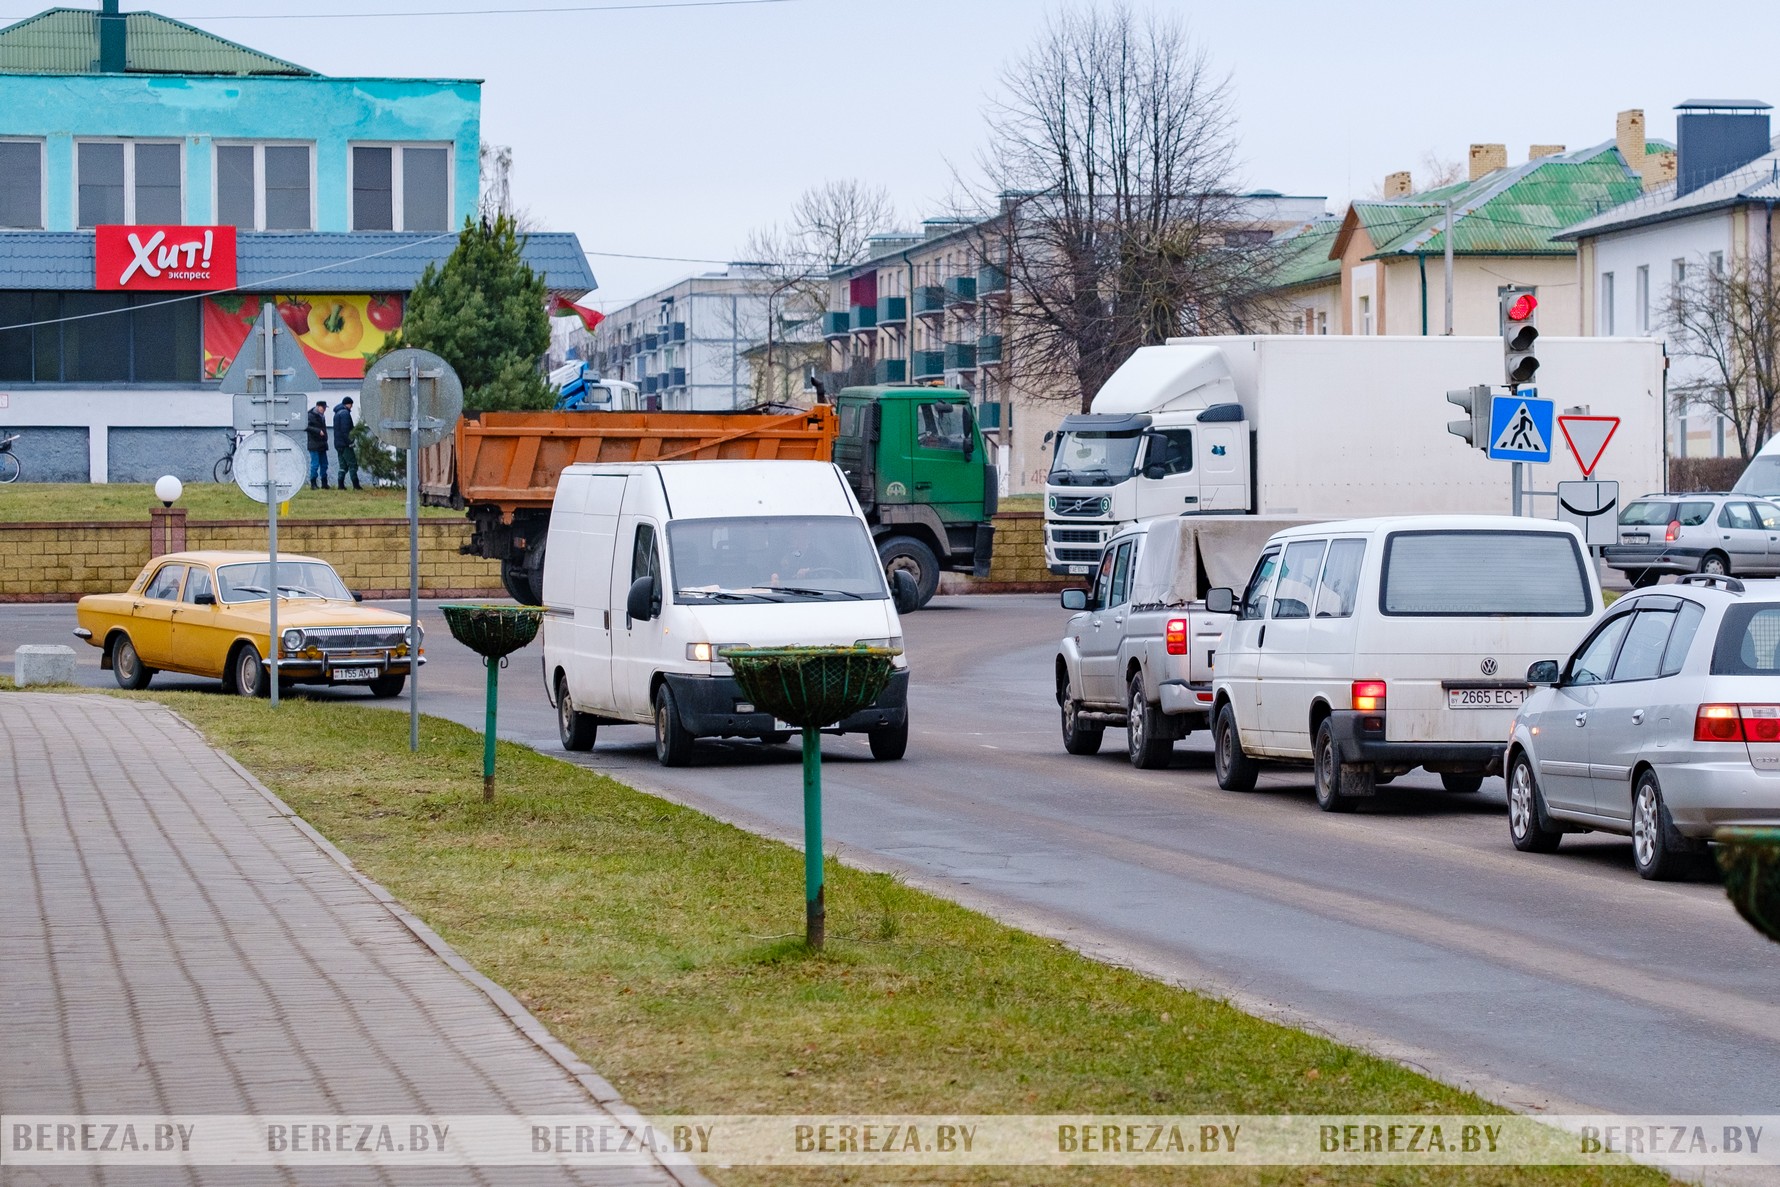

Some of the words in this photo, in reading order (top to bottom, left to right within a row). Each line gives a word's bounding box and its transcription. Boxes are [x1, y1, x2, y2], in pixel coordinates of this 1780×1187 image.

[120, 230, 213, 286] Хит!
[168, 271, 210, 281] экспресс
[340, 669, 357, 679] 1155
[358, 668, 377, 678] AM-1
[1461, 690, 1491, 704] 2665
[1495, 690, 1525, 703] EC-1
